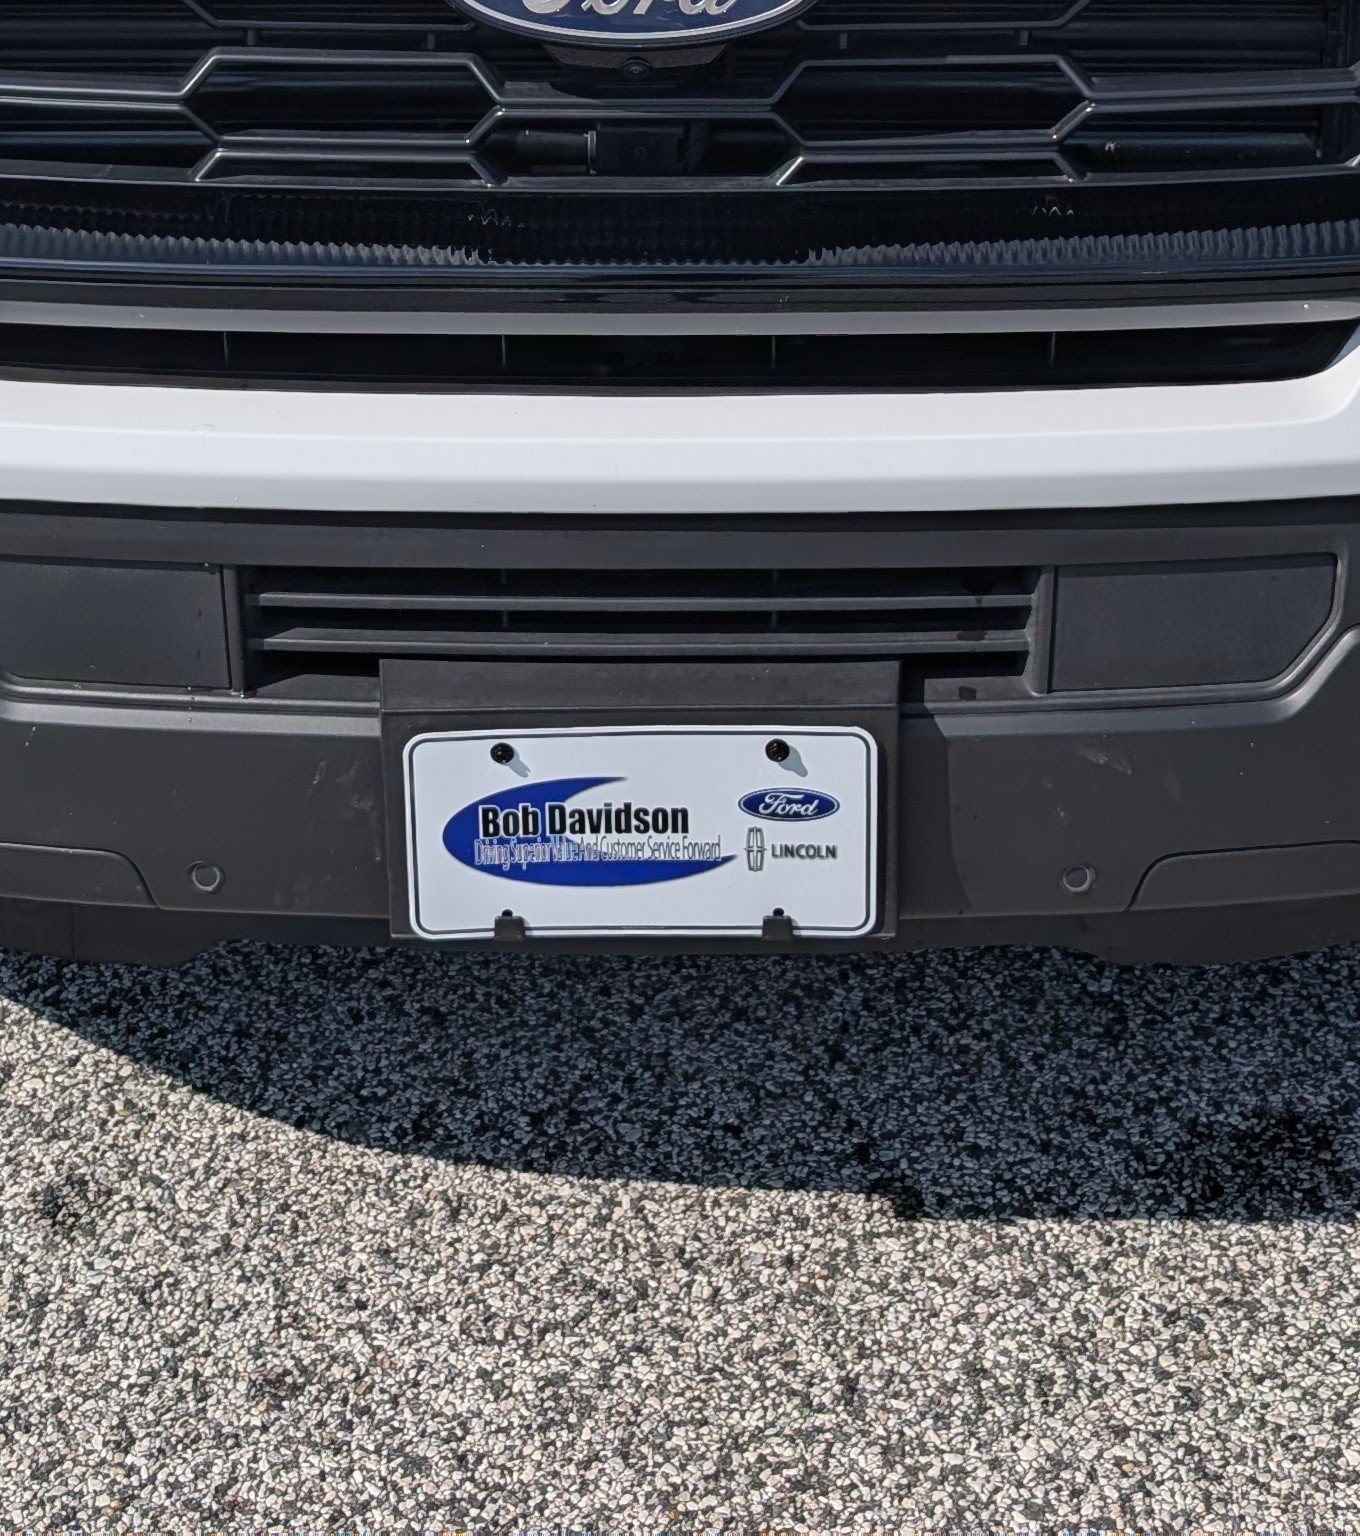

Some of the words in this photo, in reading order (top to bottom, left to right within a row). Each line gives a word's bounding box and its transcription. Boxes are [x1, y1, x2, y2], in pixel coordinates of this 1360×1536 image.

[758, 792, 820, 816] Ford
[480, 804, 540, 838] Bob
[547, 802, 690, 835] Davidson
[474, 838, 510, 870] Driving
[511, 838, 551, 869] Superior
[580, 835, 598, 860] And
[599, 836, 646, 860] Customer
[647, 835, 681, 860] Service
[682, 834, 722, 861] Forward
[771, 843, 838, 860] LINCOLN
